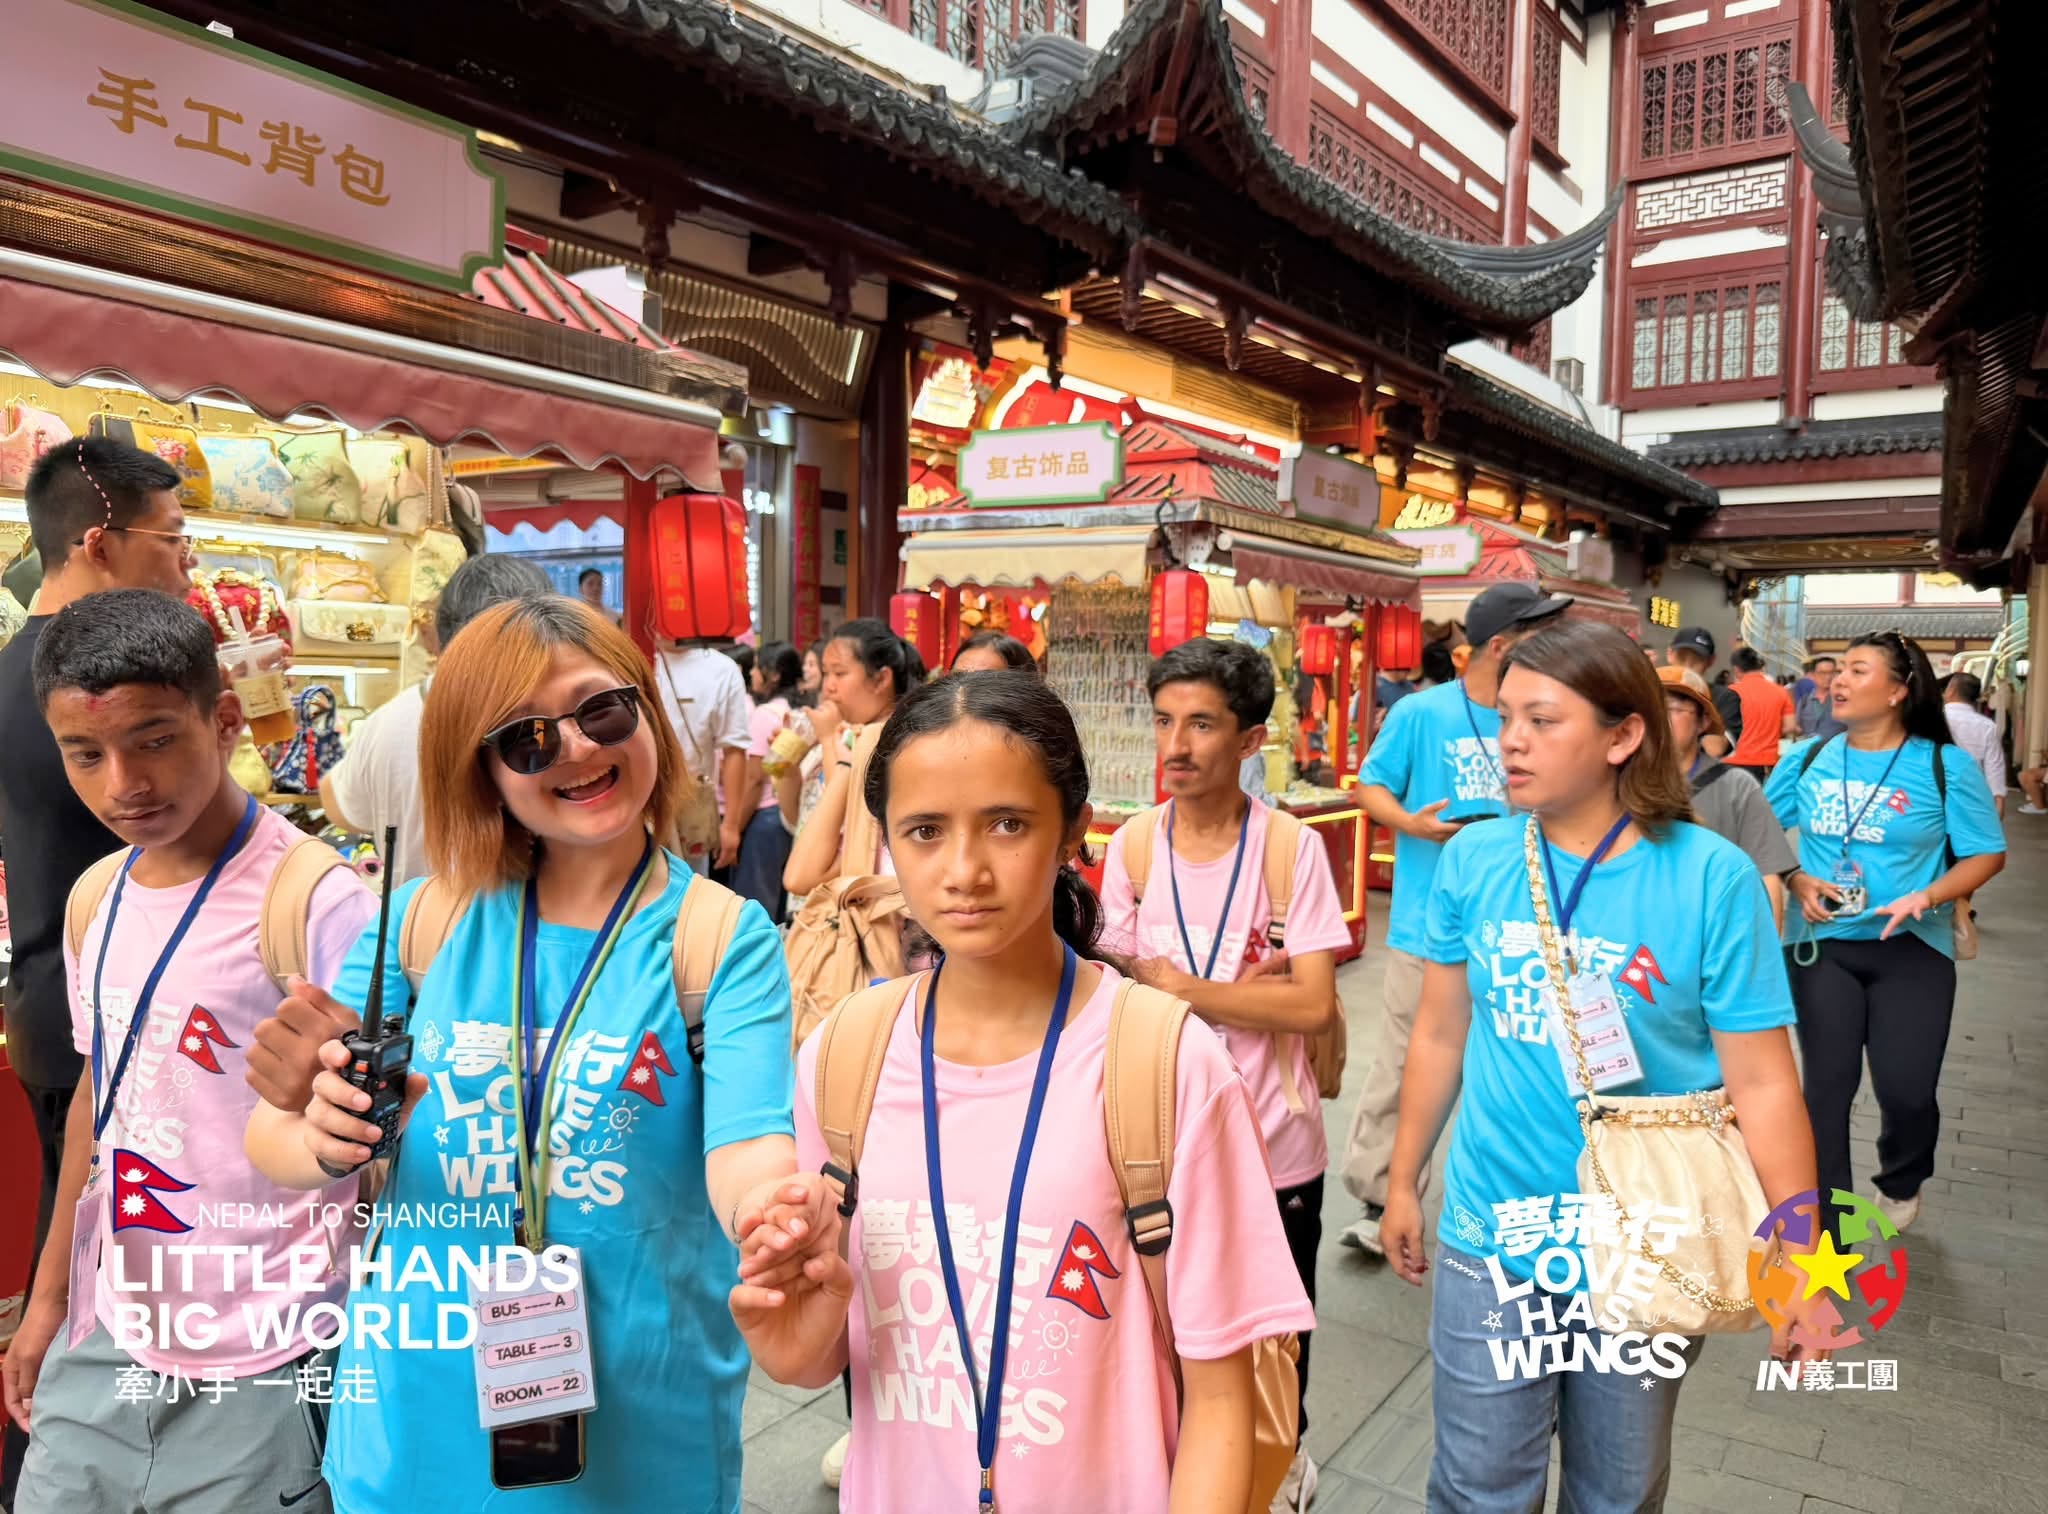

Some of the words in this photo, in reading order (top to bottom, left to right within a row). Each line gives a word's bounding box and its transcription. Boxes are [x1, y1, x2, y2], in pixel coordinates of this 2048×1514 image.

[86, 66, 392, 207] 手工背包
[986, 451, 1089, 480] 复古饰品
[1497, 920, 1627, 973] 夢行
[1575, 1066, 1606, 1080] ROM
[433, 1070, 602, 1132] LOE
[491, 1302, 521, 1319] BUS
[554, 1294, 566, 1308] A
[864, 1268, 1032, 1349] LOVE
[495, 1343, 537, 1361] TABLE
[563, 1336, 573, 1348] 3
[495, 1385, 542, 1405] ROOM
[563, 1377, 579, 1391] 22
